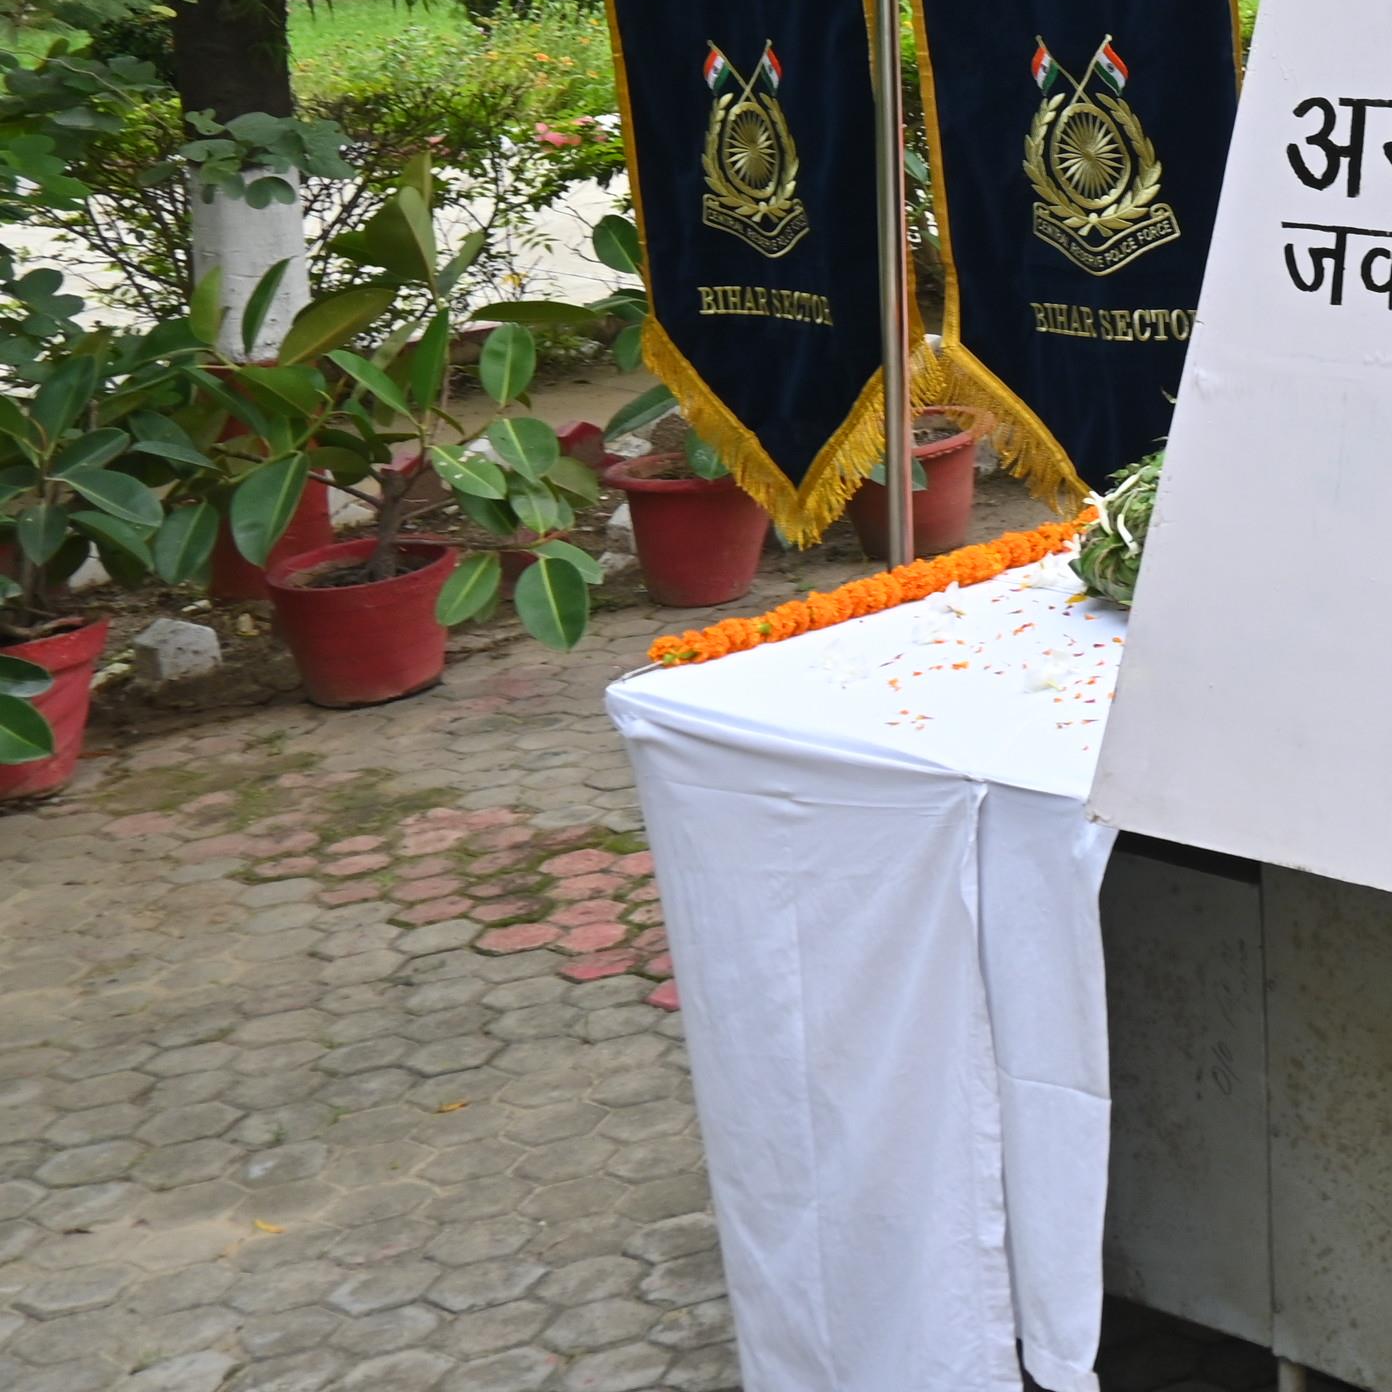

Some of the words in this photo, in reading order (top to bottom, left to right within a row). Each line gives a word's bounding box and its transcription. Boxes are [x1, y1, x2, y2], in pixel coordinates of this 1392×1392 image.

[1136, 219, 1174, 245] FORCE
[697, 286, 770, 316] BIHAR
[771, 289, 833, 326] SECTOR
[1029, 302, 1098, 338] BIHAR
